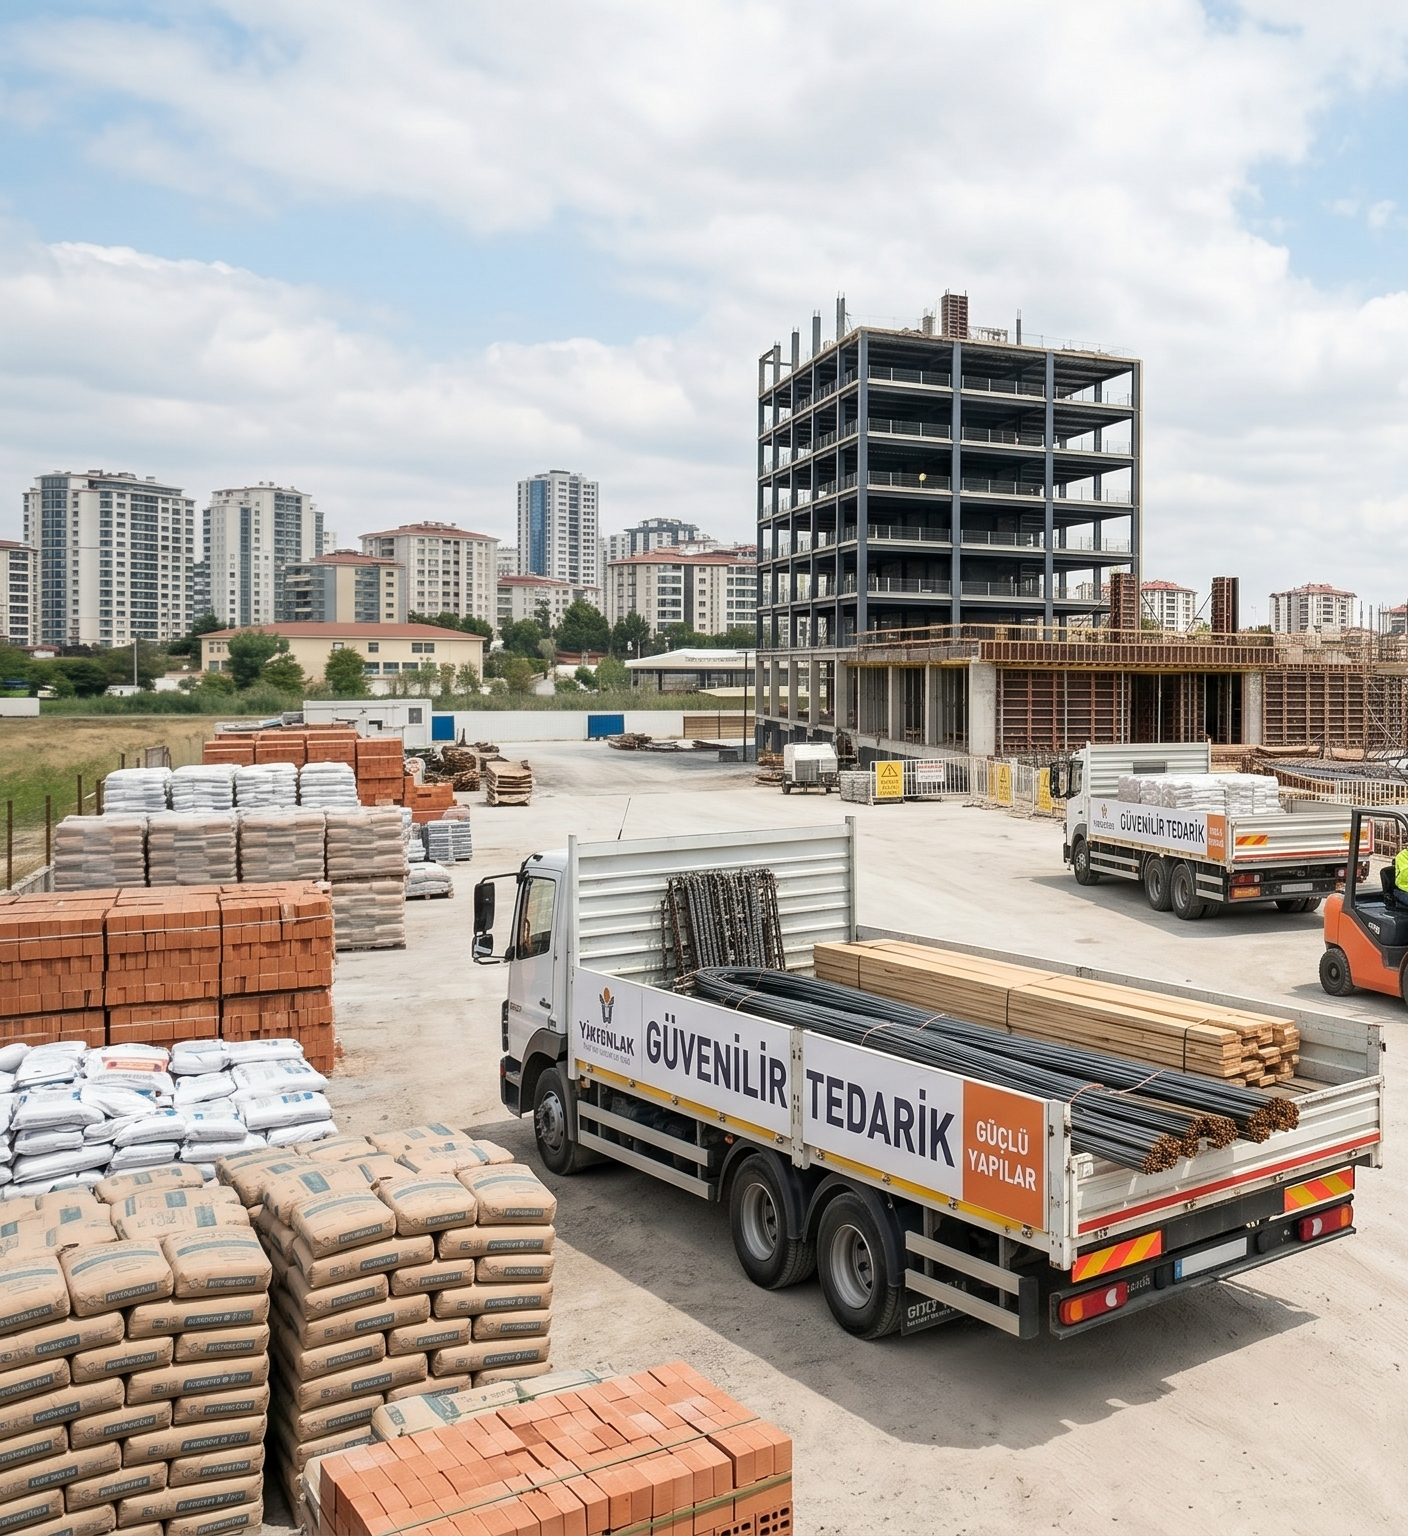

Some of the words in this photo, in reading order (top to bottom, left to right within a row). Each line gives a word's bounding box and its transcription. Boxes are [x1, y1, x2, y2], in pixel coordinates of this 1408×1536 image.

[1120, 810, 1164, 837] GÜVENİLİR
[1167, 819, 1205, 843] TEDARİK
[646, 1013, 787, 1109] GÜVENİLİR
[806, 1068, 956, 1168] TEDARİK
[976, 1120, 1029, 1155] GÜÇLÜ
[968, 1149, 1036, 1192] YAPILAR
